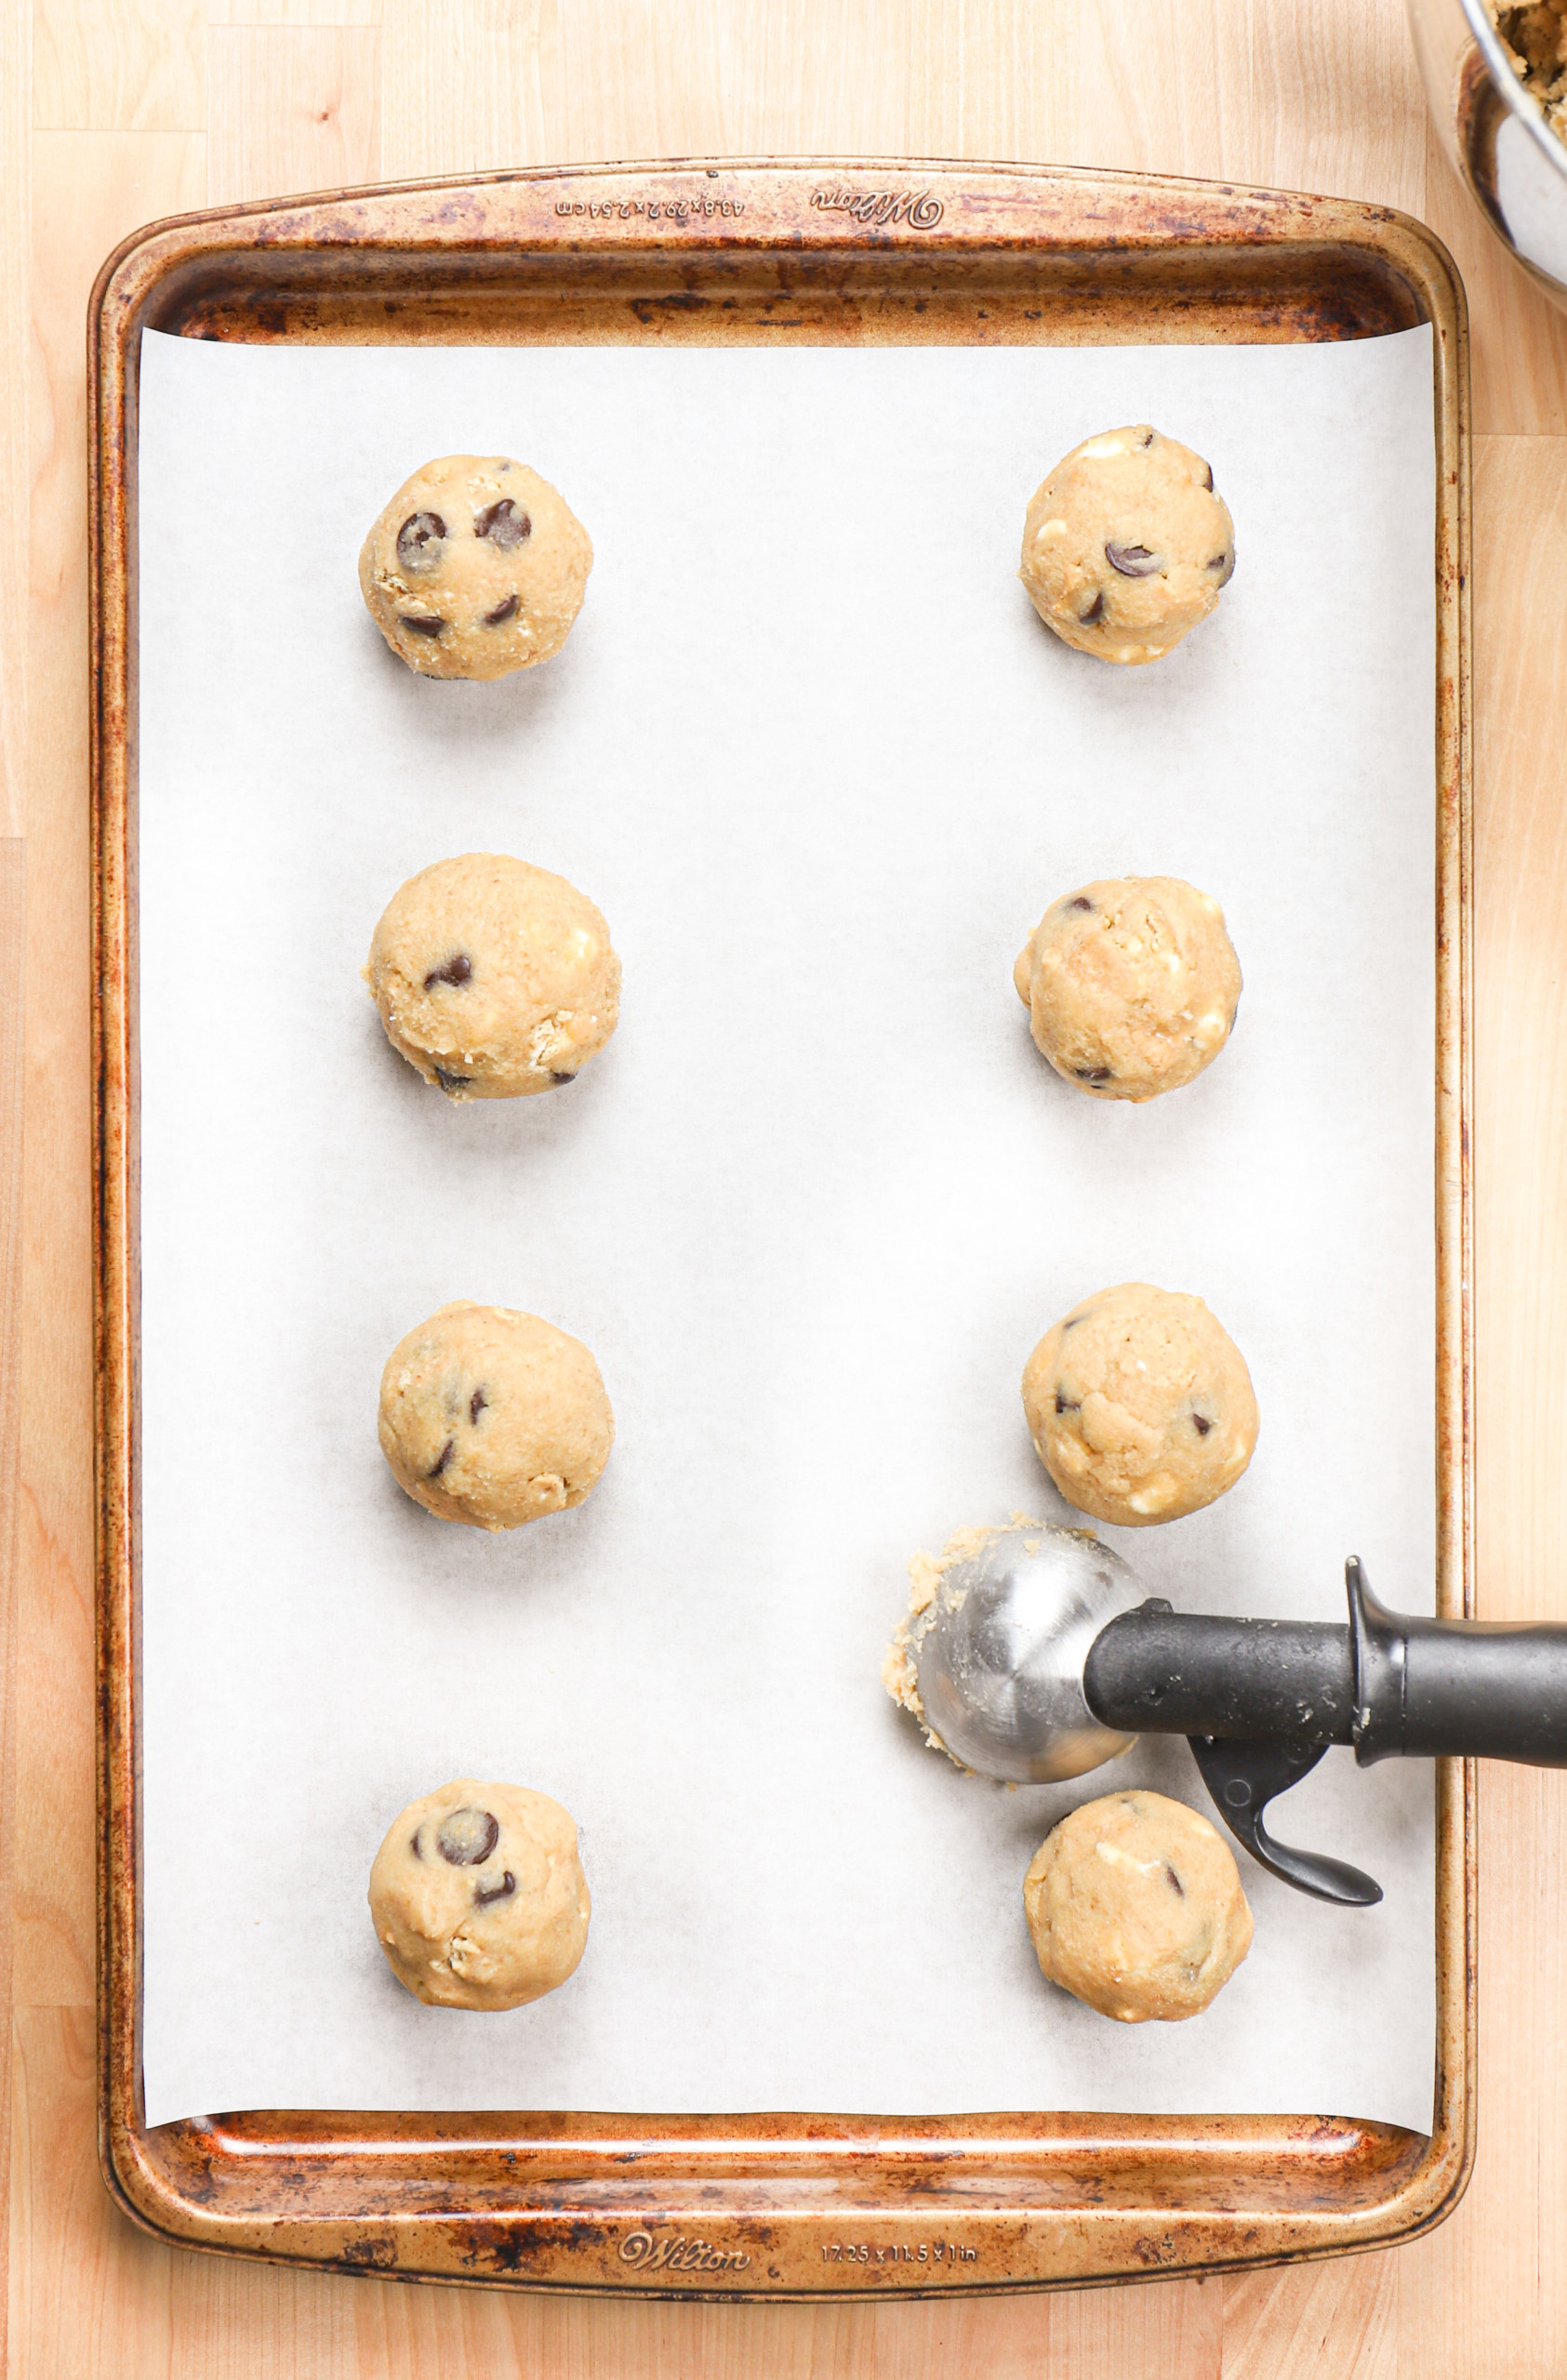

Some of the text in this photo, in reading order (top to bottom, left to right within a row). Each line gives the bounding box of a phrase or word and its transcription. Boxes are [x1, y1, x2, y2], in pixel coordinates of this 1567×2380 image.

[811, 190, 945, 231] Wilton
[618, 2231, 750, 2272] Wilton
[821, 2244, 870, 2263] 17.25
[875, 2249, 885, 2263] x
[892, 2244, 928, 2263] 11.5
[934, 2248, 943, 2262] x
